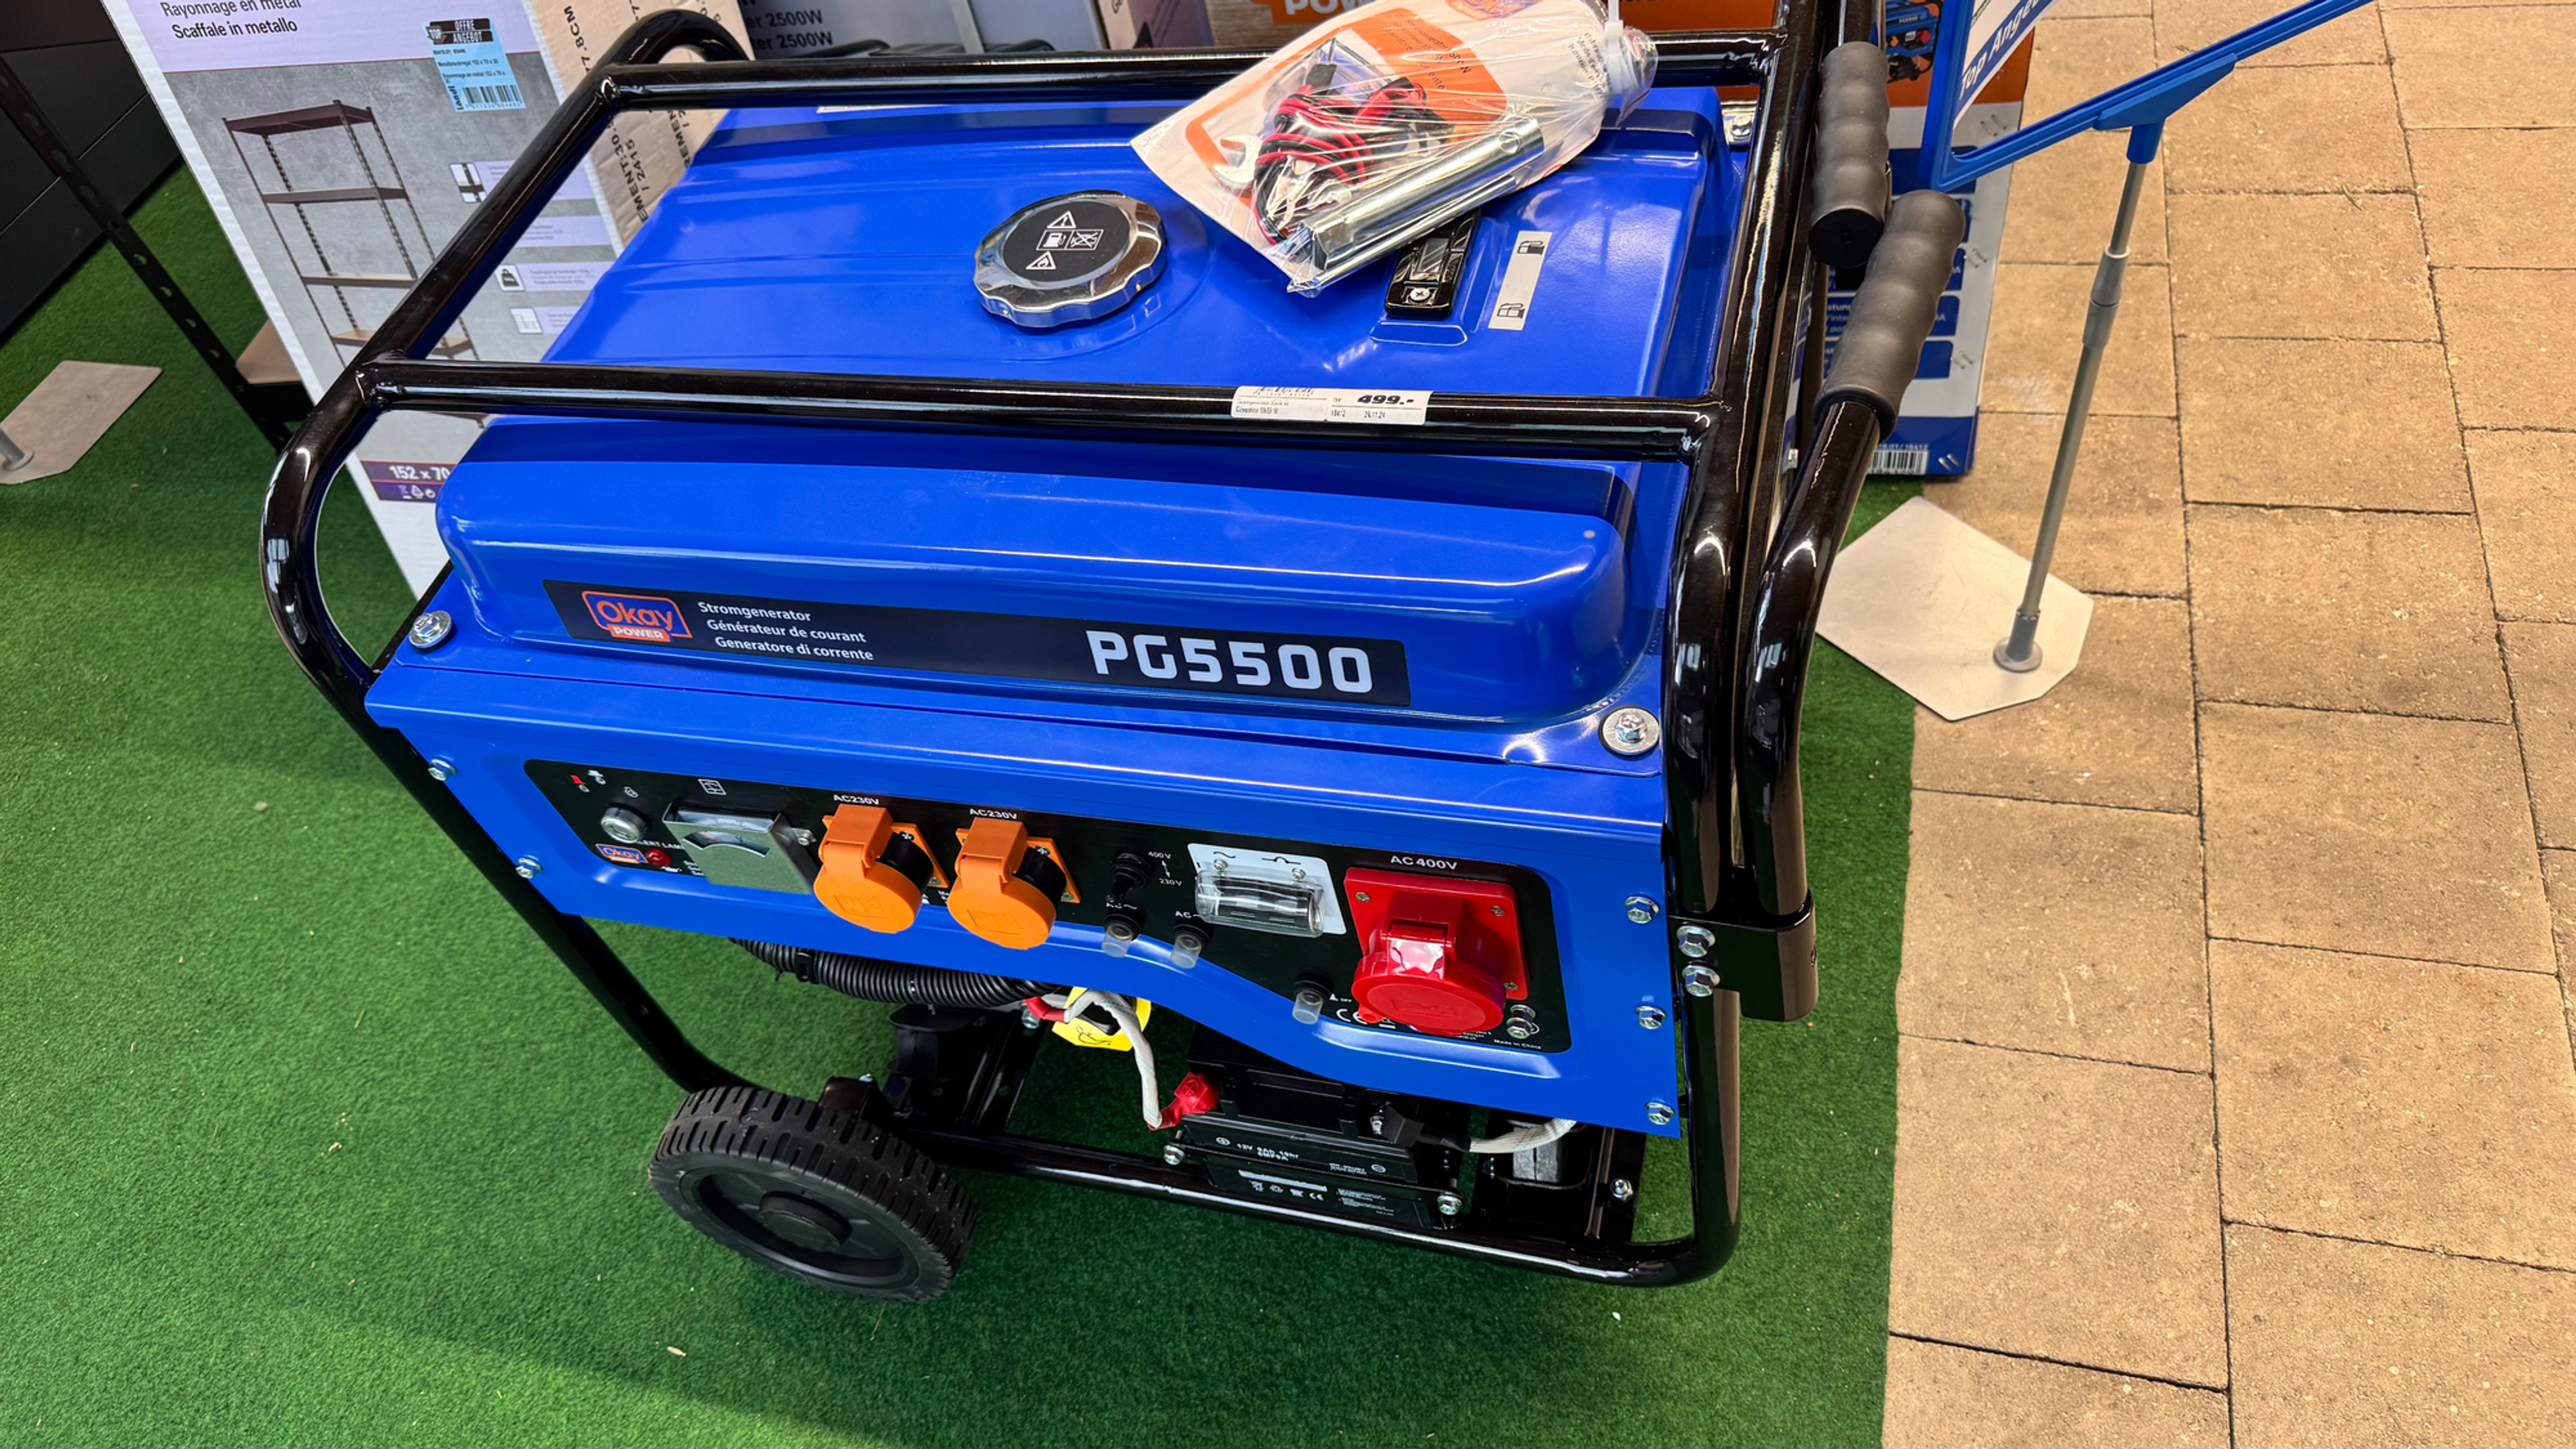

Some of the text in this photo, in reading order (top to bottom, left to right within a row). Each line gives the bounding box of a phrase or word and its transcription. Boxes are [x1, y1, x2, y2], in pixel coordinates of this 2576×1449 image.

[160, 1, 238, 18] Rayonnage
[240, 0, 258, 11] en
[766, 9, 823, 27] 2500W
[171, 17, 298, 39] Scaffale in metallo
[455, 20, 475, 31] OFFRE
[453, 32, 483, 43] ANGEBOT
[776, 31, 833, 48] 2500W
[1959, 51, 1987, 100] Top
[1357, 395, 1415, 405] 499.-
[389, 465, 419, 479] 152
[419, 470, 431, 479] x
[597, 600, 673, 629] Okay
[698, 602, 811, 622] Stromgenerator
[612, 626, 665, 639] POWER
[707, 619, 866, 643] Générateur de courant
[714, 636, 874, 661] Generatore di corrente
[1086, 630, 1373, 693] PG5500
[833, 794, 879, 805] AC230V
[970, 809, 1017, 819] AC230V
